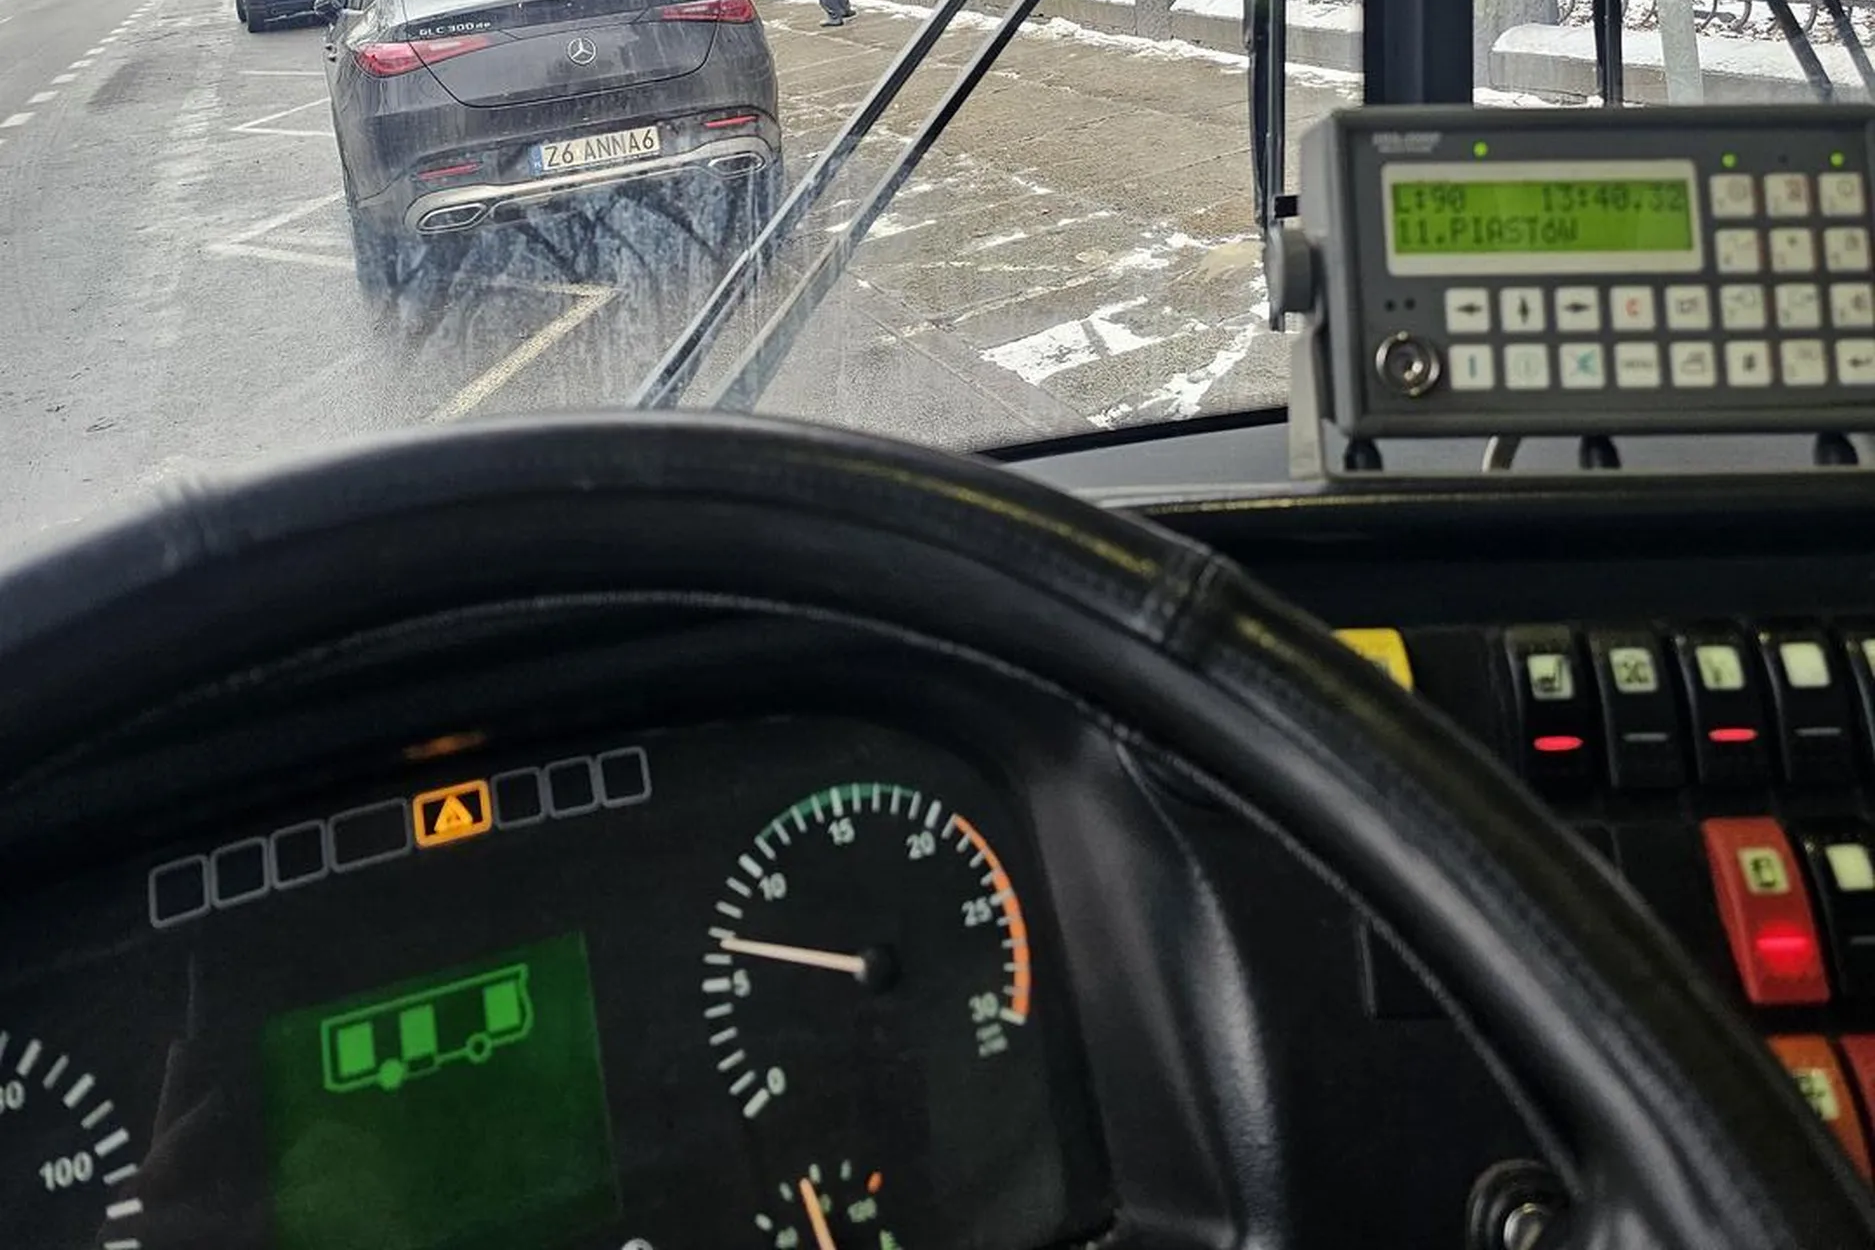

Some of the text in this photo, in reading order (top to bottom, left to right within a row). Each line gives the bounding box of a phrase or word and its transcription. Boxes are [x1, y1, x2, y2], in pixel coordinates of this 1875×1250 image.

[544, 128, 655, 168] Z6 ANNA6
[828, 817, 855, 846] 15
[906, 830, 936, 860] 20
[758, 872, 787, 901] 10
[961, 896, 992, 927] 25
[733, 968, 751, 998] 5
[968, 992, 999, 1023] 30
[766, 1066, 786, 1095] 0
[0, 1079, 25, 1115] 0
[38, 1151, 94, 1192] 100
